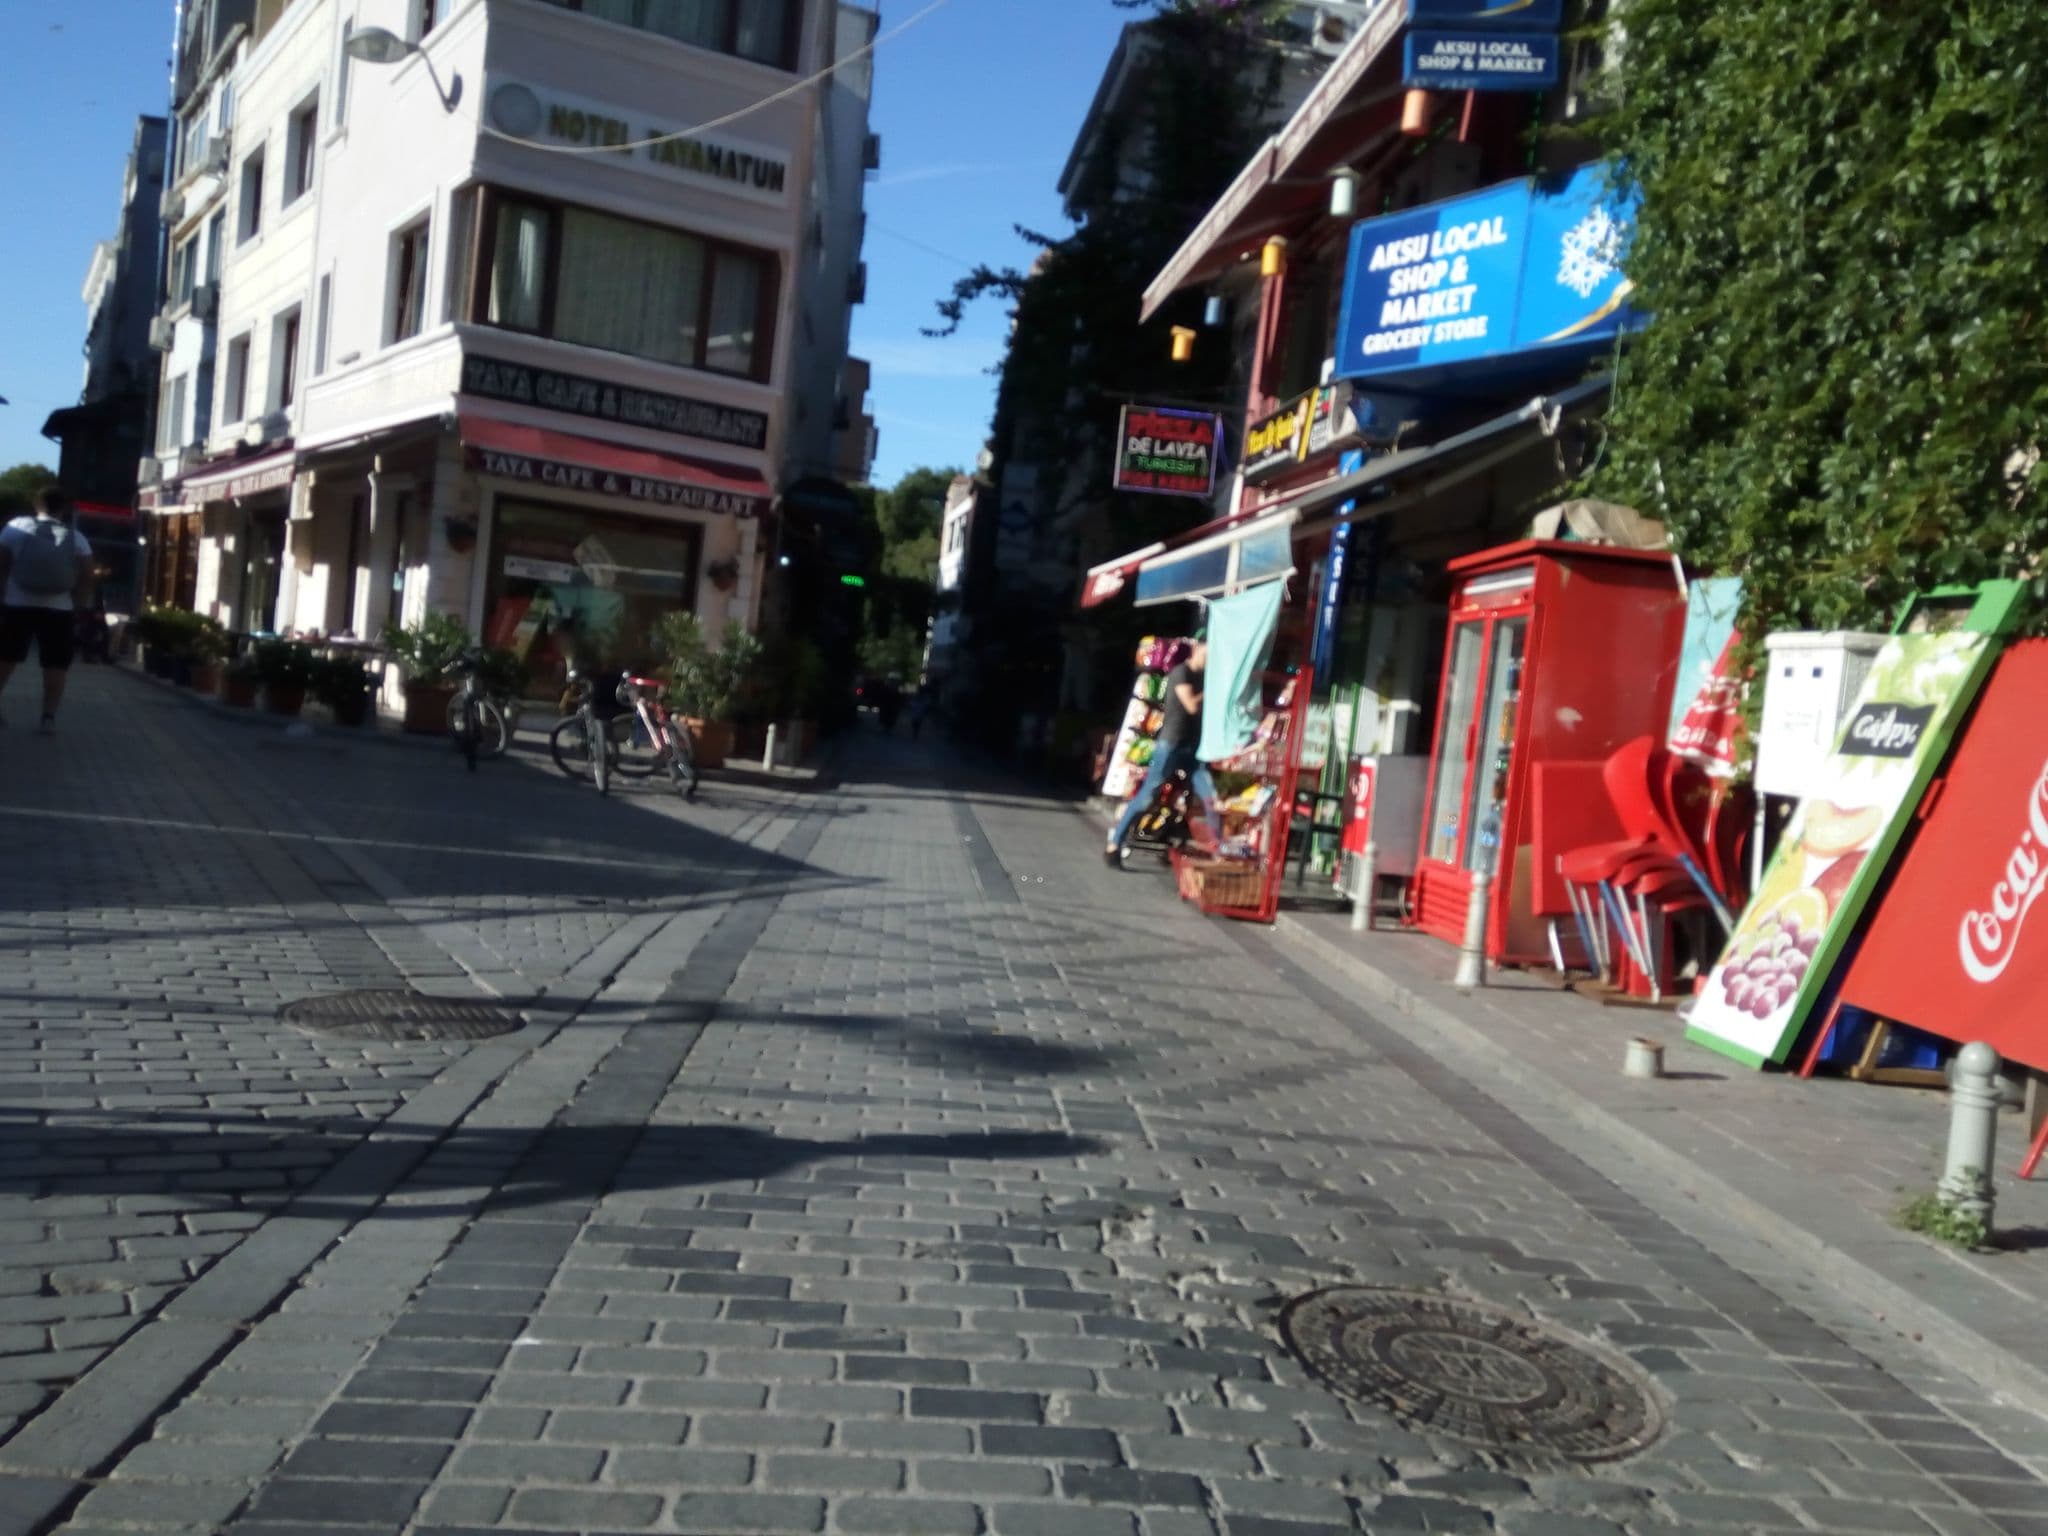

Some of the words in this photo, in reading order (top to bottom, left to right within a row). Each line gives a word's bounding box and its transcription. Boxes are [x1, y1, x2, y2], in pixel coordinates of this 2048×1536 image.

[1417, 55, 1460, 70] SHOP
[1462, 57, 1474, 71] &
[1477, 56, 1546, 72] MARKET
[1433, 40, 1476, 55] AKSU
[1479, 41, 1532, 57] LOCAL
[1369, 233, 1427, 272] AKSU
[1430, 215, 1508, 258] LOCAL
[1388, 260, 1448, 297] SHOP
[1450, 255, 1469, 285] &
[1379, 284, 1477, 327] MARKET
[1362, 323, 1432, 355] GROCERY
[1434, 315, 1488, 342] STORE
[483, 452, 532, 479] TAYA
[541, 463, 596, 490] CAFE
[603, 474, 619, 492] &
[630, 478, 755, 514] RESTAURANT
